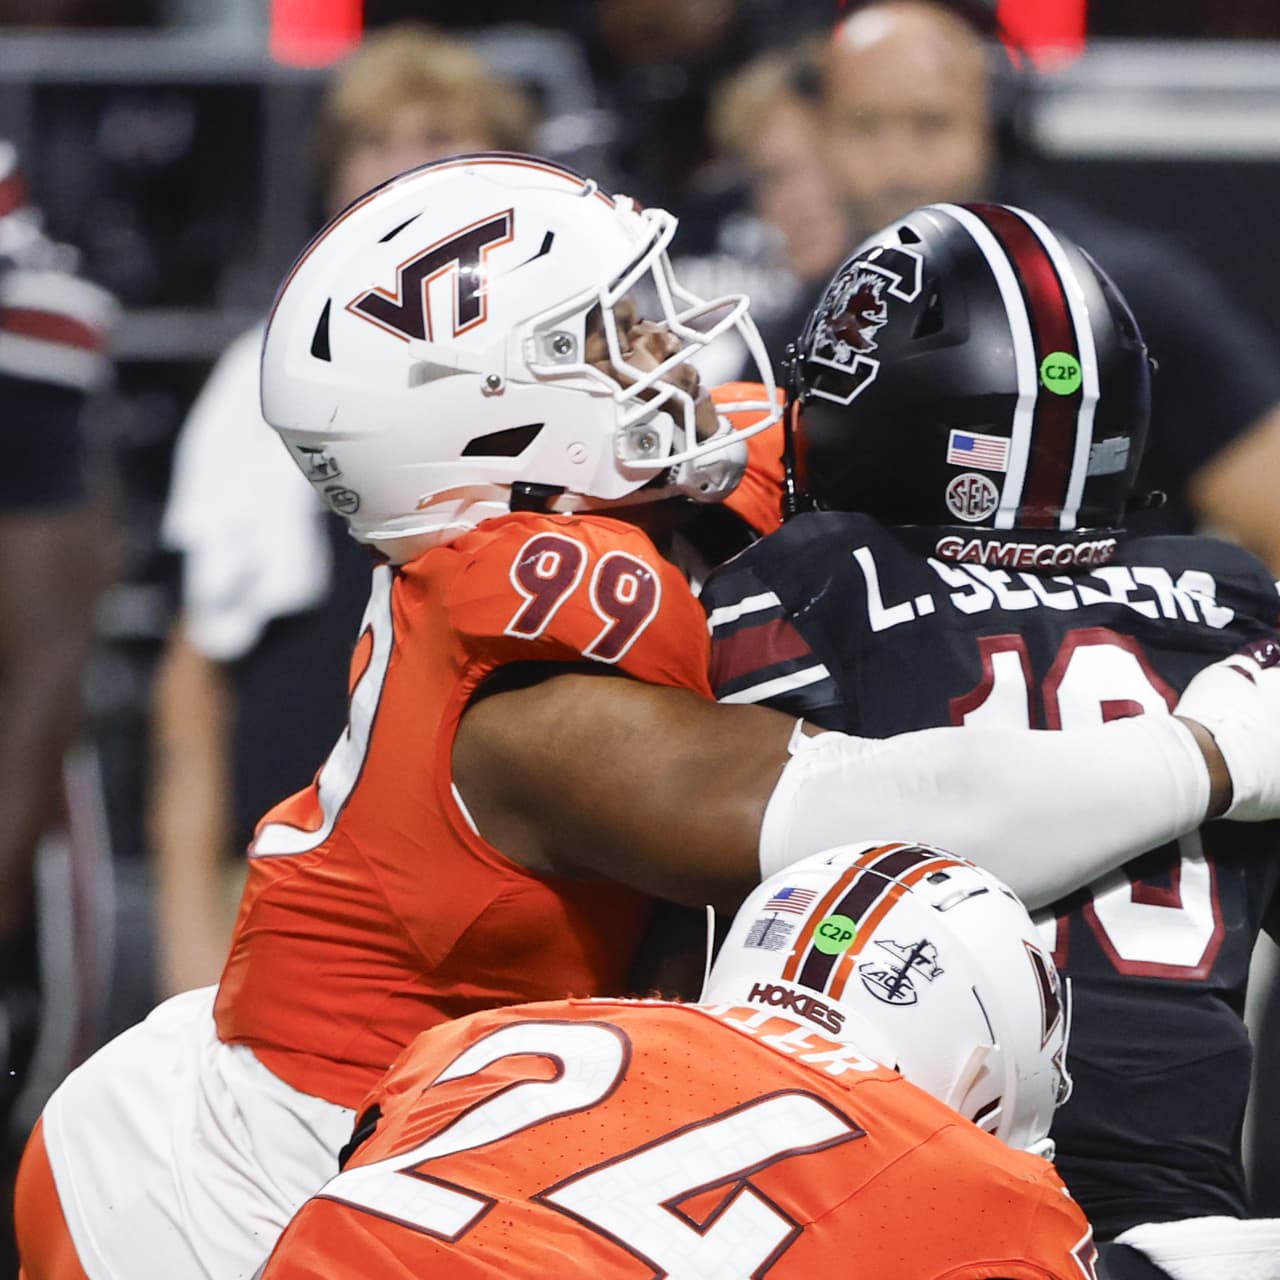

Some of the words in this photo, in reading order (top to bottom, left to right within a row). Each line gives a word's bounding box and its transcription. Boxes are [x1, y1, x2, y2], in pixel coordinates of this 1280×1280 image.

[1045, 365, 1078, 380] C2P
[949, 475, 999, 517] SEC
[935, 536, 1117, 571] GAMECOCKS
[504, 528, 662, 664] 99
[819, 922, 853, 944] C2P
[747, 982, 846, 1035] HOKIES
